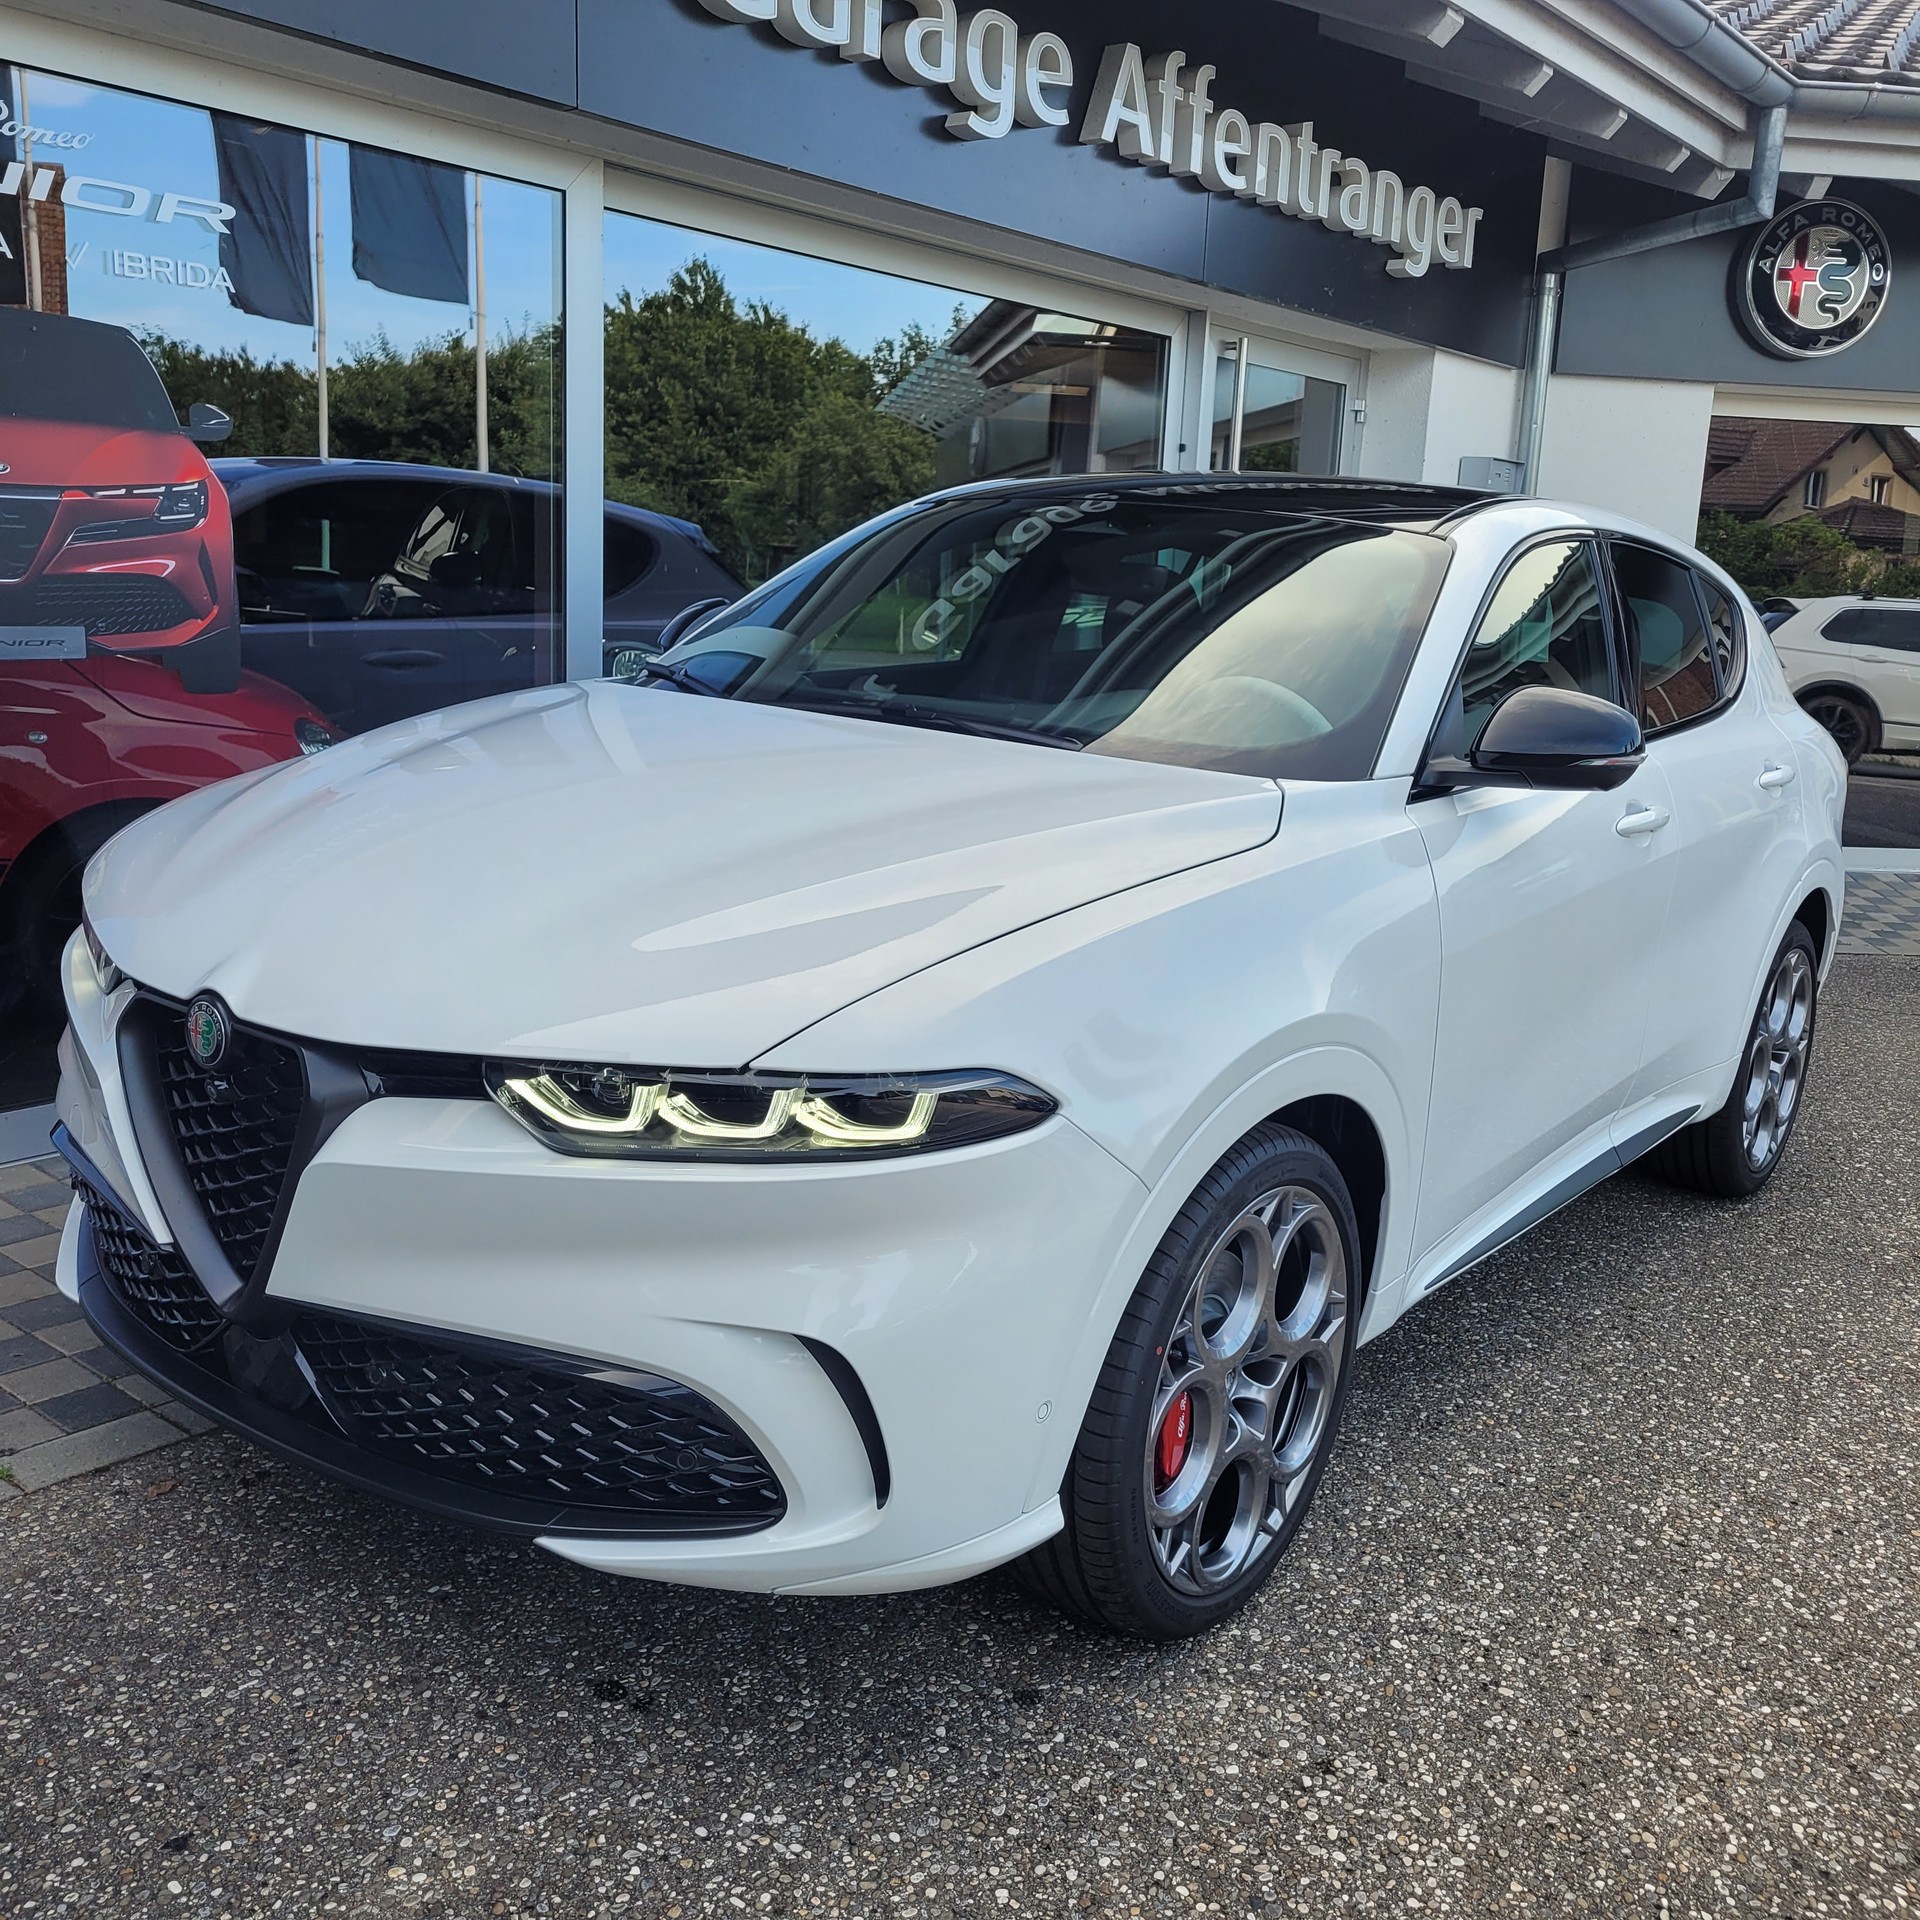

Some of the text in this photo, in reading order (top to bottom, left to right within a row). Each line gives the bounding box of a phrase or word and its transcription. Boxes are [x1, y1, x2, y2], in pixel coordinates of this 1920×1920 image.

[1082, 42, 1484, 278] Affentranger
[113, 249, 236, 294] IBRIDA
[1758, 206, 1884, 282] ALFA ROMEO
